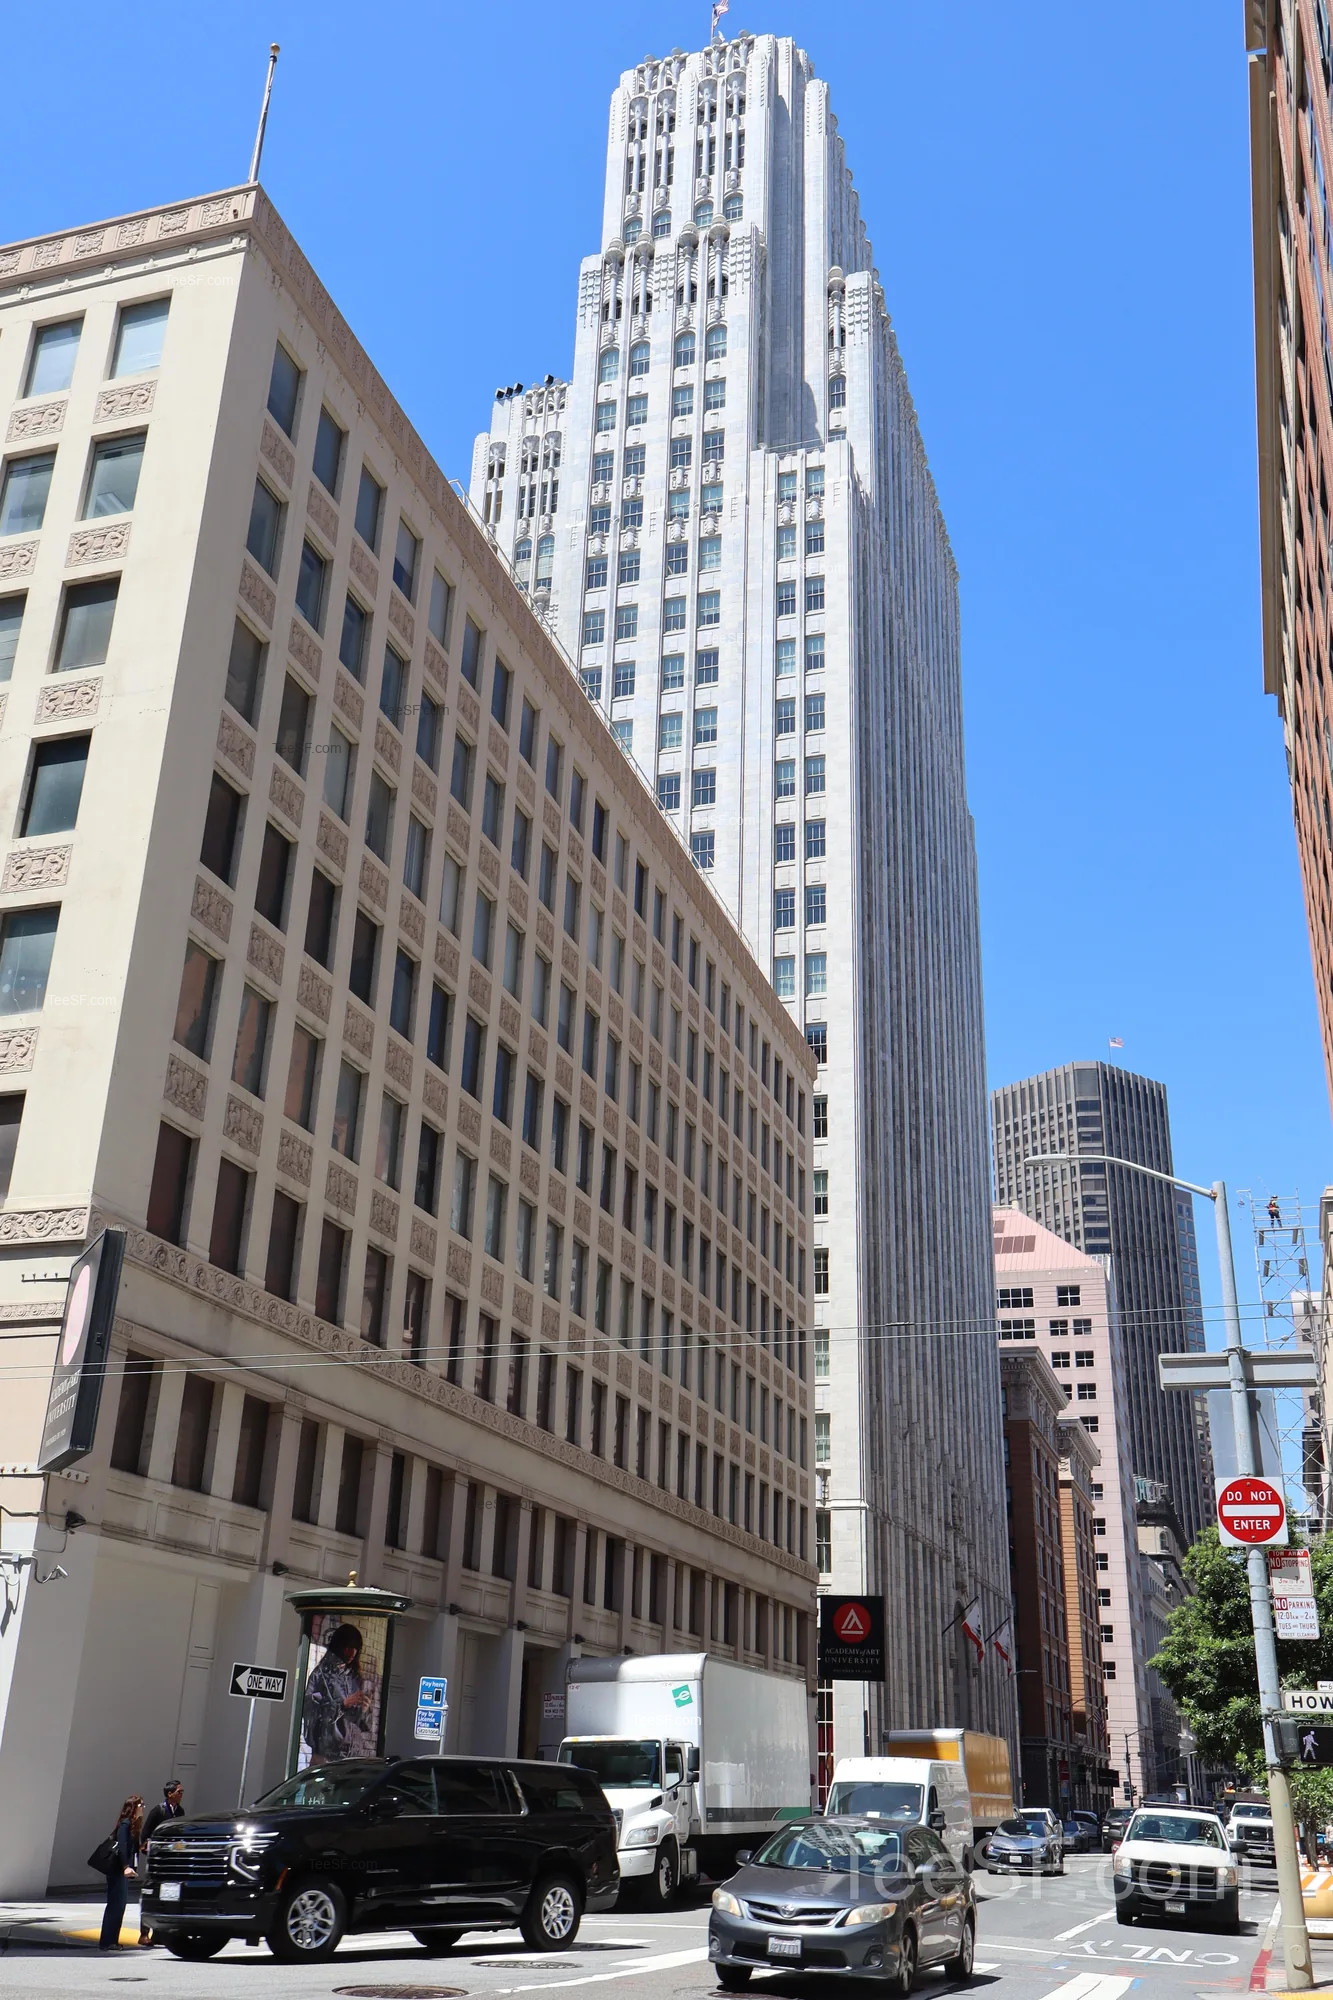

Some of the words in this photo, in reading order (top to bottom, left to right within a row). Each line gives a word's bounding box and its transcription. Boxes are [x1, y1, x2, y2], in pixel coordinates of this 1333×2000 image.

[1227, 1491, 1243, 1502] DO
[1250, 1490, 1273, 1501] NOT
[1233, 1519, 1271, 1531] ENTER
[1270, 1557, 1281, 1568] NO
[1282, 1559, 1309, 1568] STOPPING
[1275, 1598, 1288, 1609] NO
[1289, 1600, 1315, 1609] PARKING
[1279, 1622, 1292, 1630] TUES
[825, 1657, 880, 1665] UNIVERSITY
[247, 1675, 263, 1689] ONE
[264, 1678, 282, 1691] WAY
[1291, 1695, 1333, 1709] HOW
